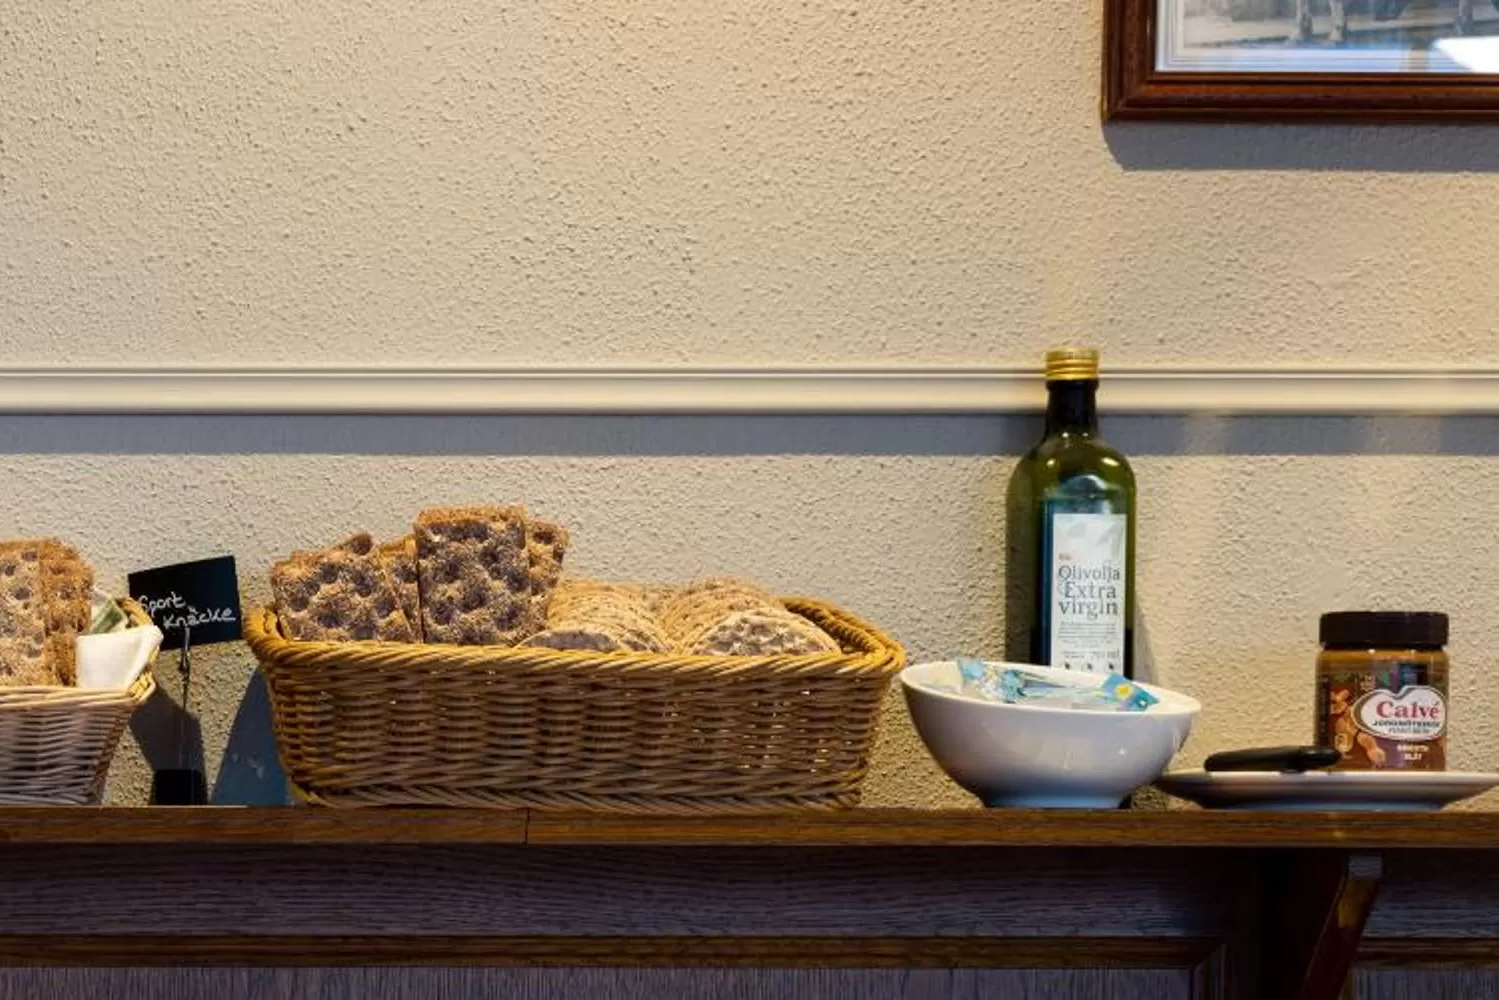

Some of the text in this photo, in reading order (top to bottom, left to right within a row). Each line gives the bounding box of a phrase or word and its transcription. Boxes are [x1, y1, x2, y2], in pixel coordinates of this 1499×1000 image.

[1064, 580, 1117, 599] Extra
[138, 591, 187, 617] Sport
[1058, 600, 1119, 620] virgin
[1376, 699, 1441, 720] Calvé
